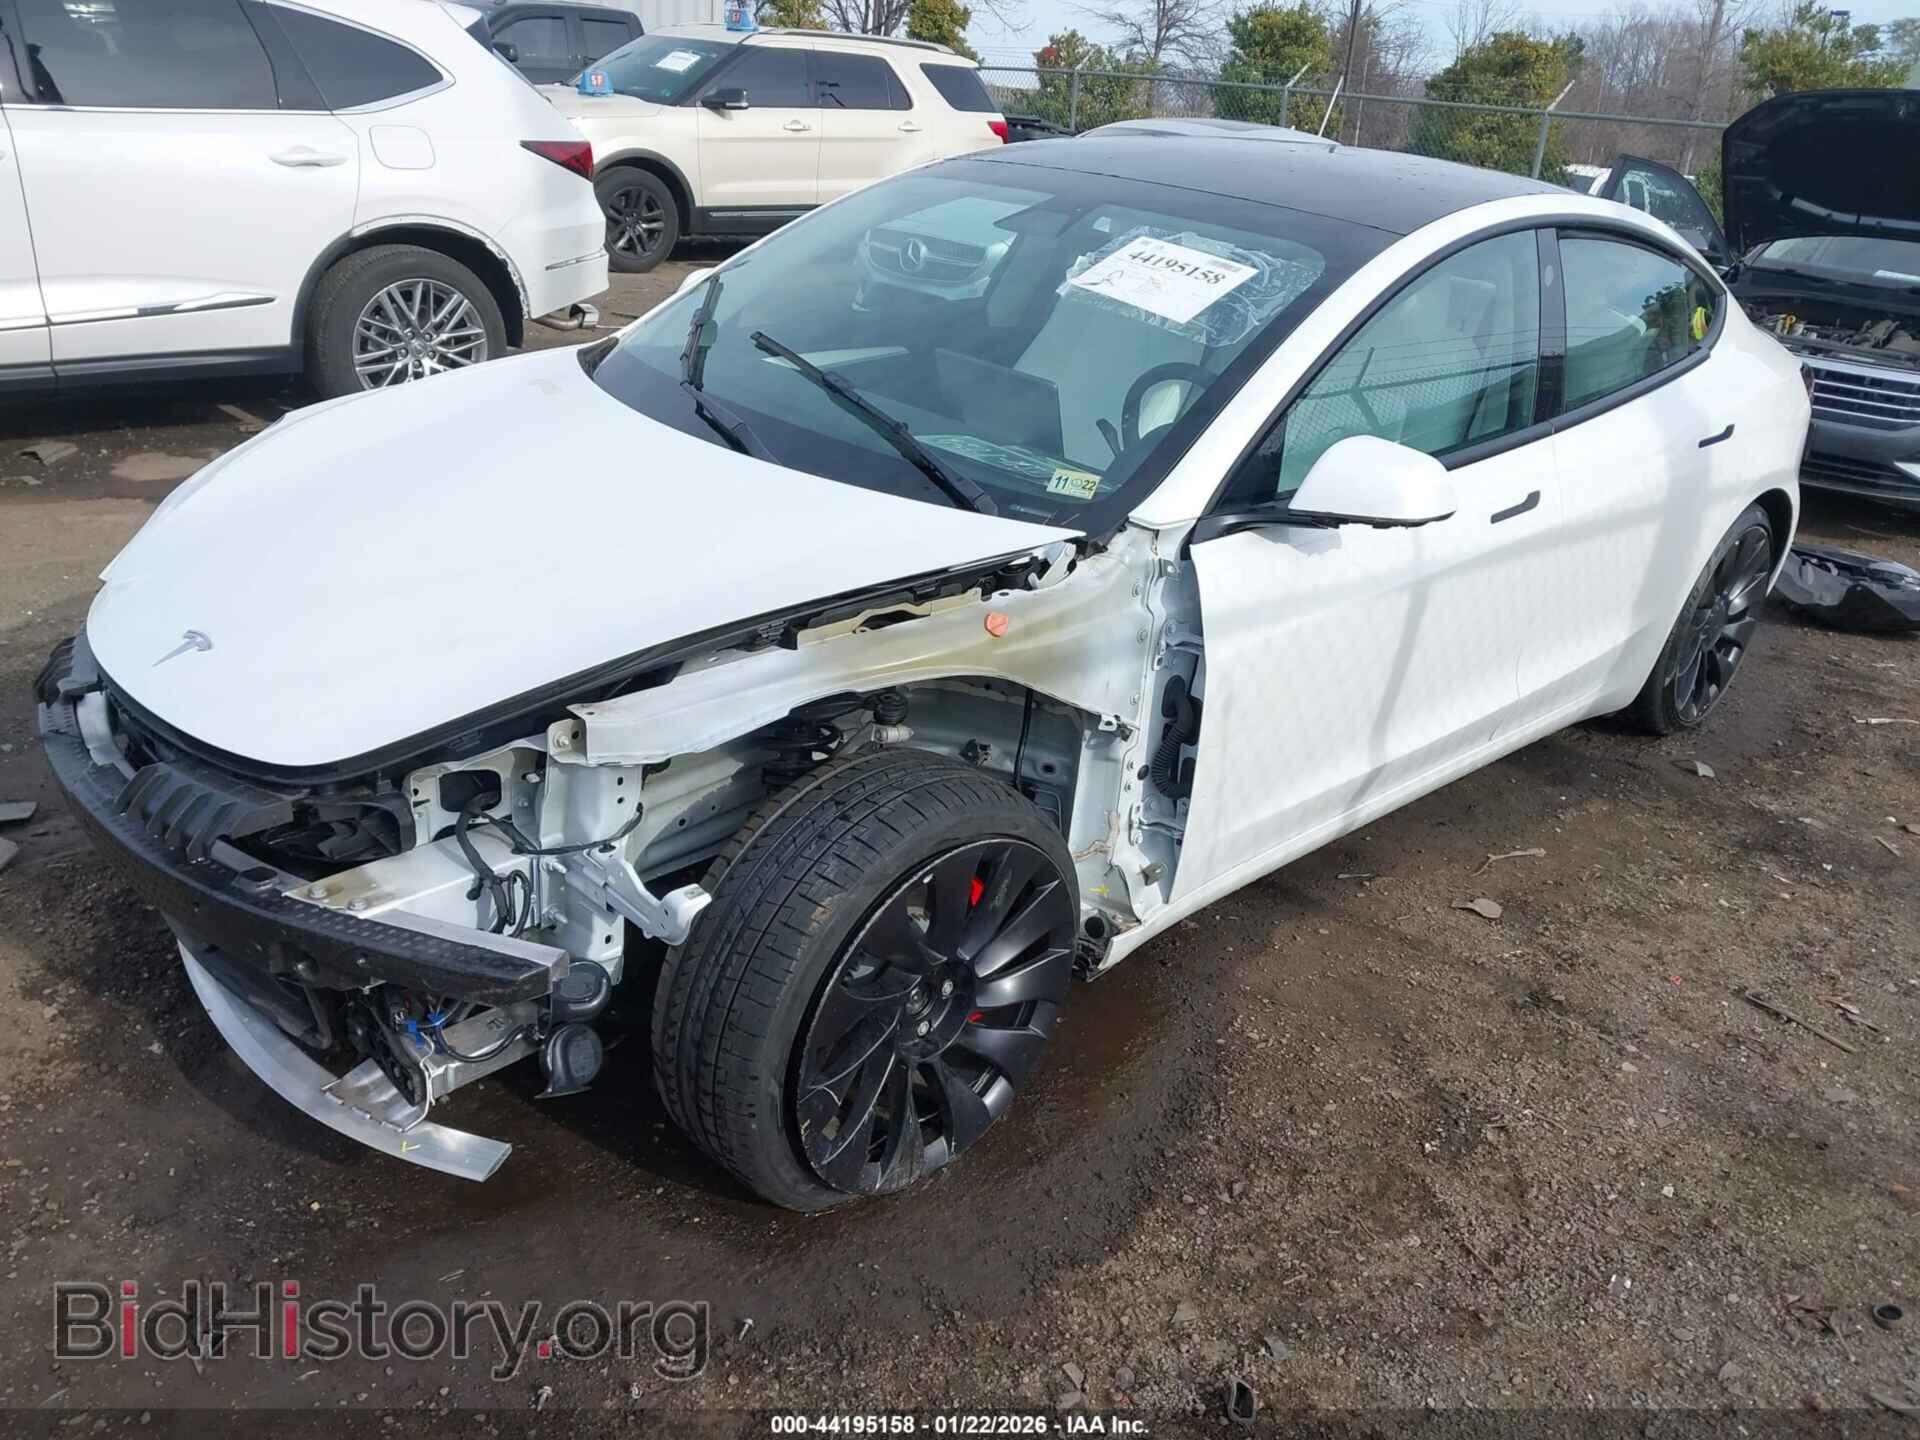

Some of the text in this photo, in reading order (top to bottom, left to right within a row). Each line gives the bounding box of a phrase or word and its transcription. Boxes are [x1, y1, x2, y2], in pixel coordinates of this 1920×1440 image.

[1129, 251, 1226, 284] 44195158
[1055, 475, 1096, 491] 11 22
